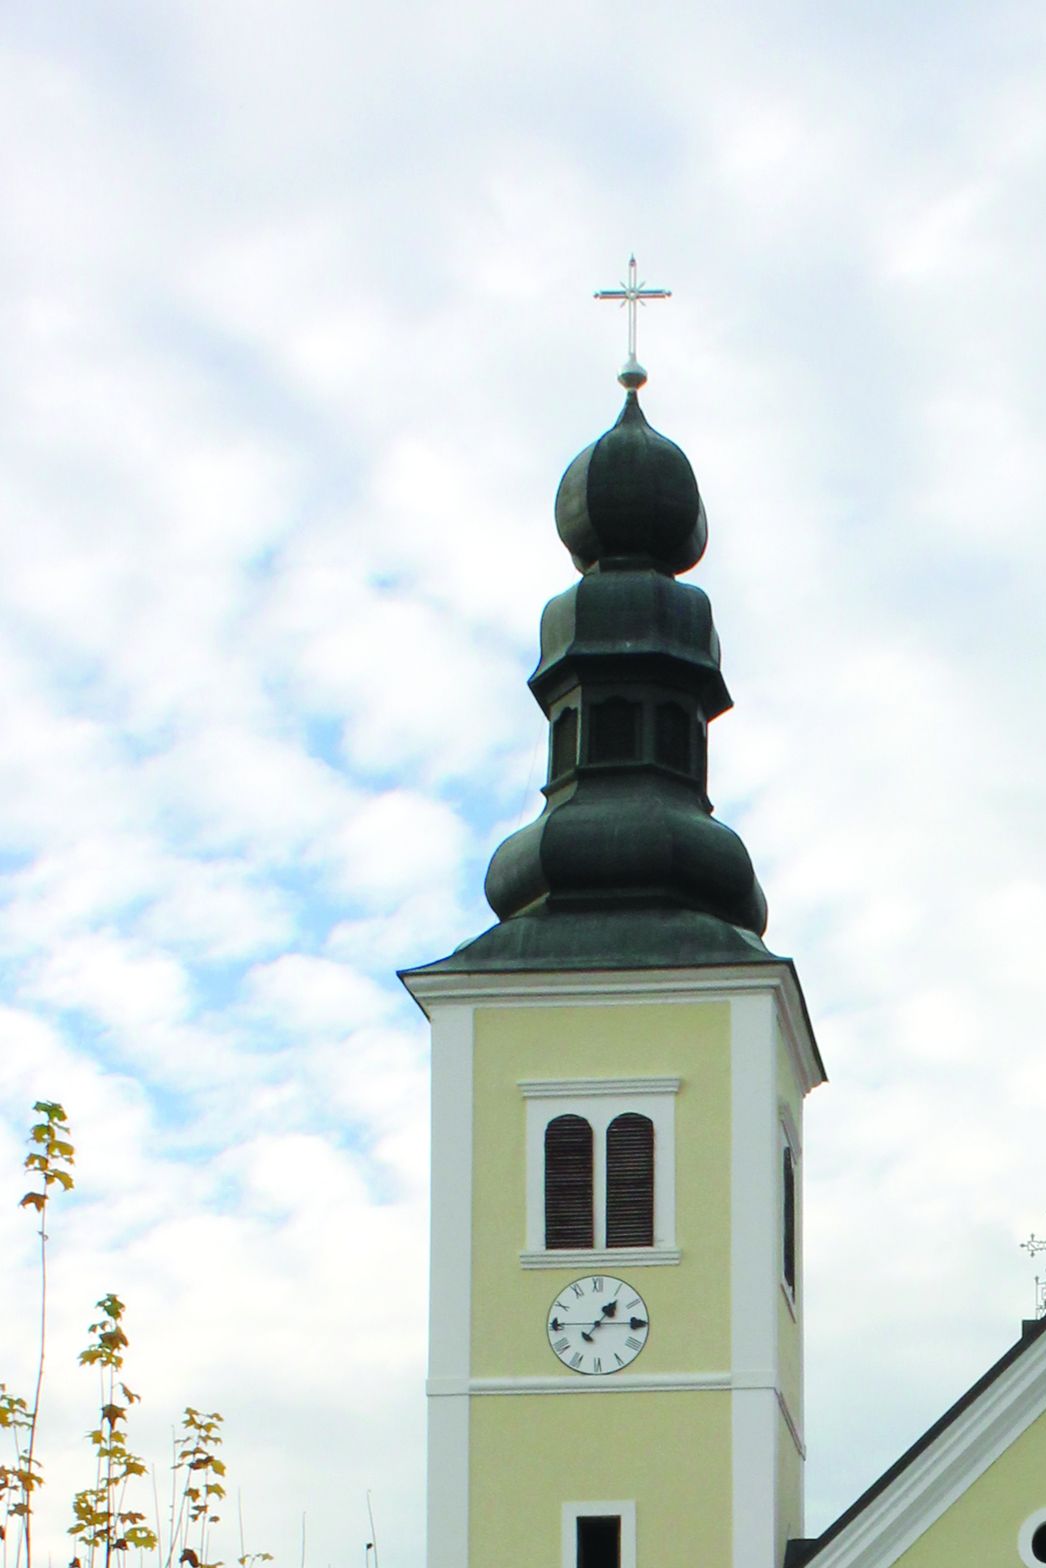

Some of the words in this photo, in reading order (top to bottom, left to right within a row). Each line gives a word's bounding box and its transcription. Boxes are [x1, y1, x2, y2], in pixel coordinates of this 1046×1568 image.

[571, 1283, 584, 1299] XI
[592, 1278, 604, 1293] XII
[555, 1301, 570, 1312] X
[626, 1298, 641, 1310] II
